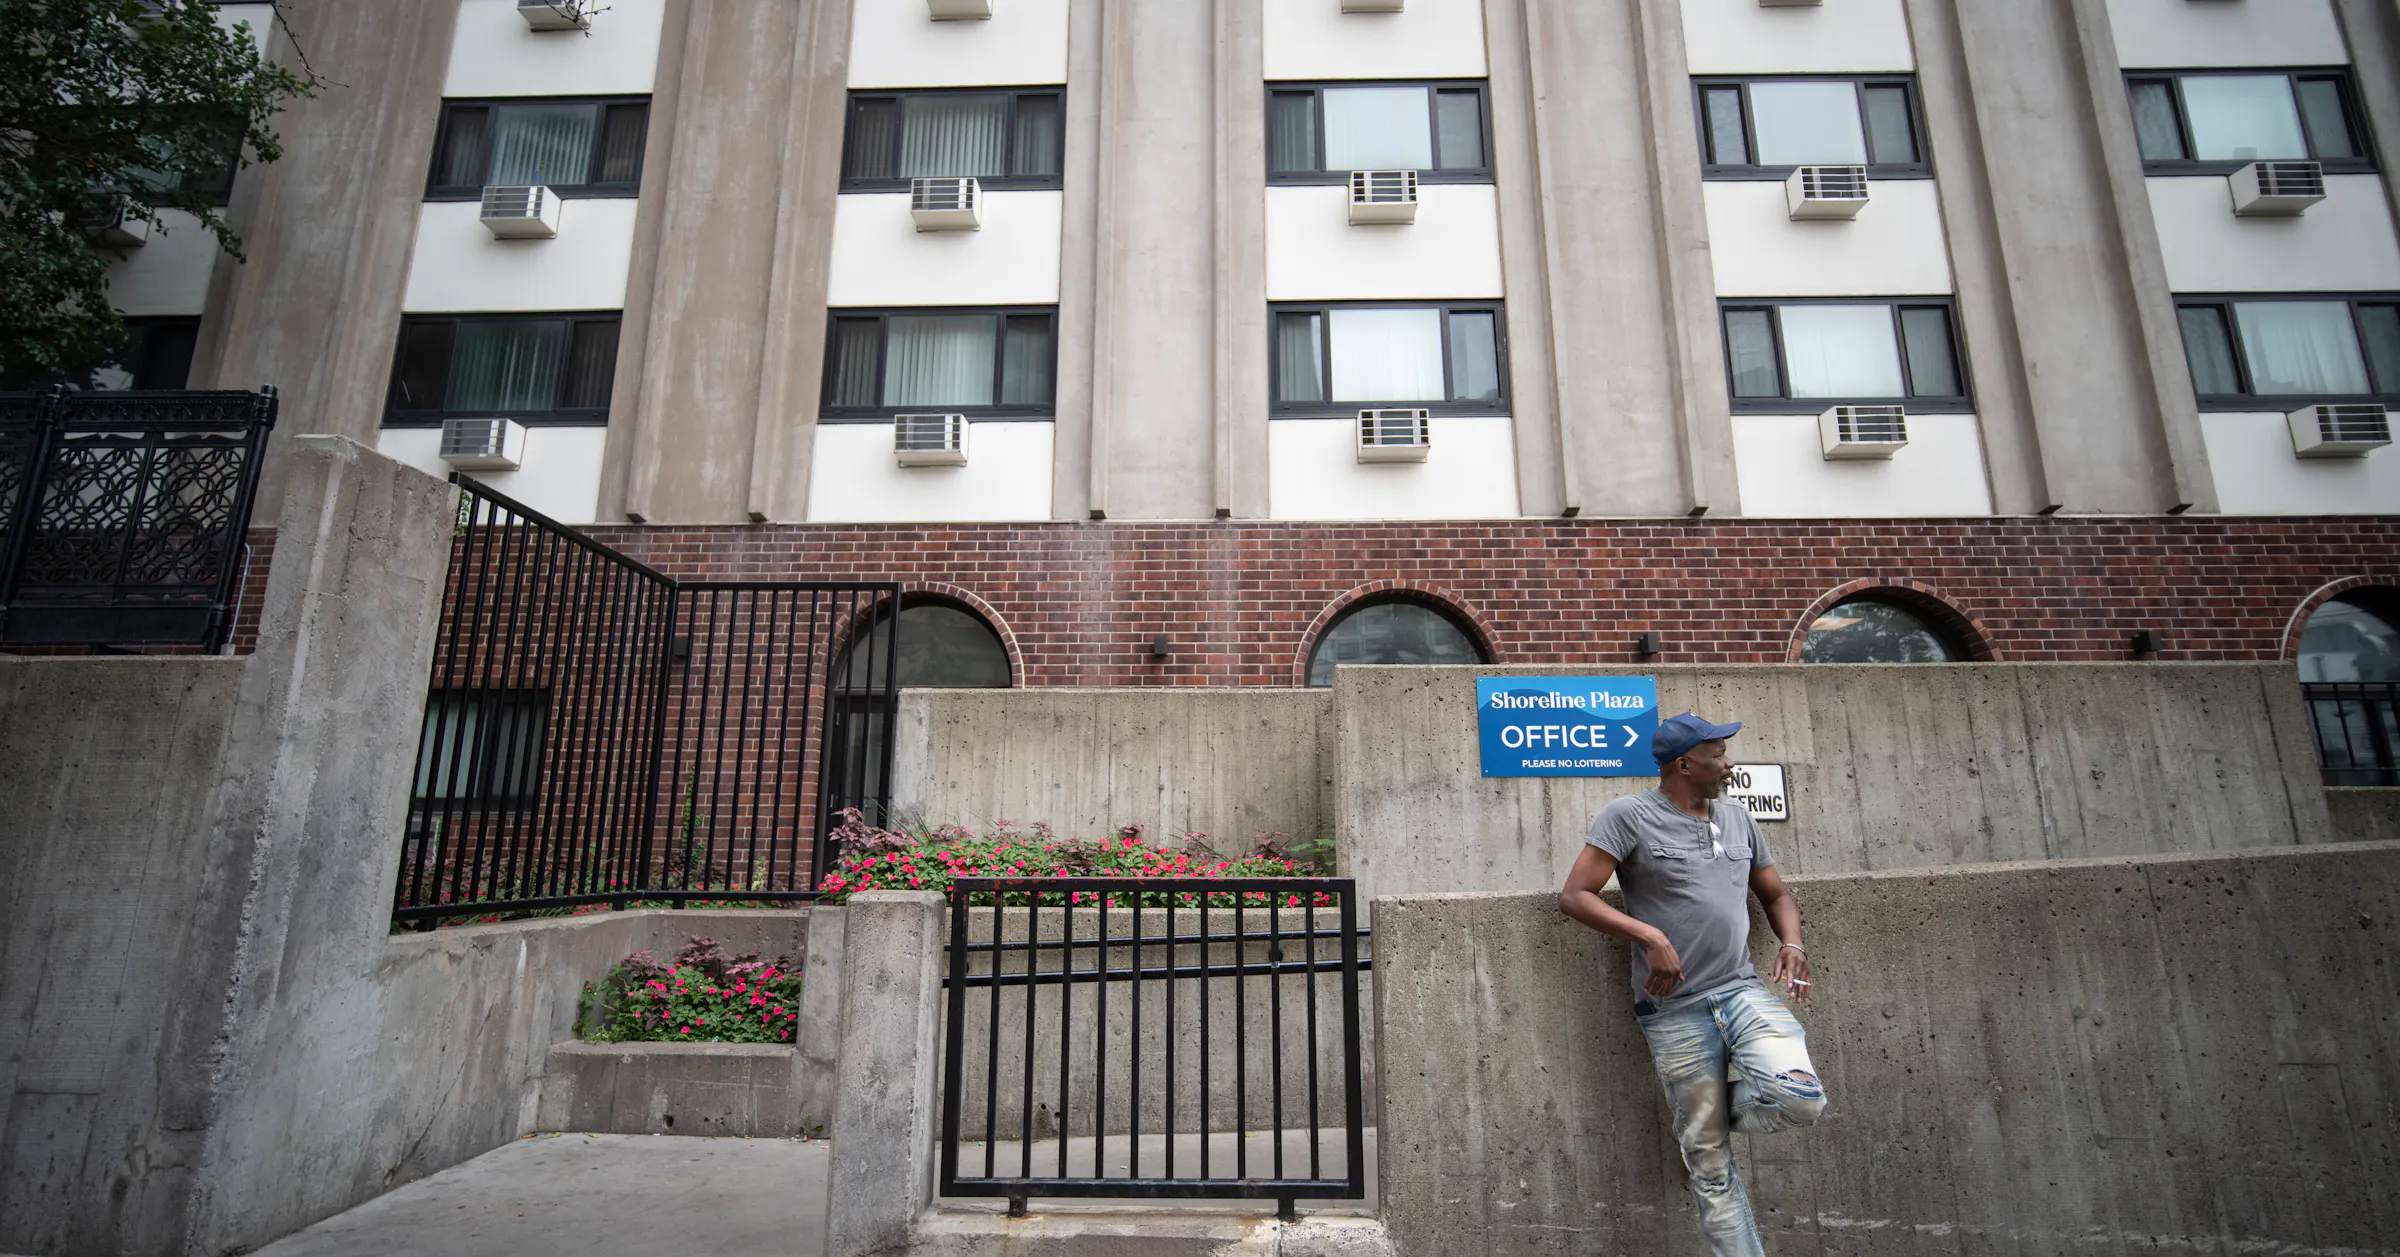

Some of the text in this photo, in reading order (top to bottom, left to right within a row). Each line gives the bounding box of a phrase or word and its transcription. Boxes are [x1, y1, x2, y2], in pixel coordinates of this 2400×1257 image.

[1491, 691, 1645, 709] Shoreline Plaza
[1501, 725, 1608, 748] OFFICE
[1522, 759, 1623, 768] PLEASE NO LOITERING
[1730, 771, 1752, 789] NO
[1730, 794, 1783, 812] RING
